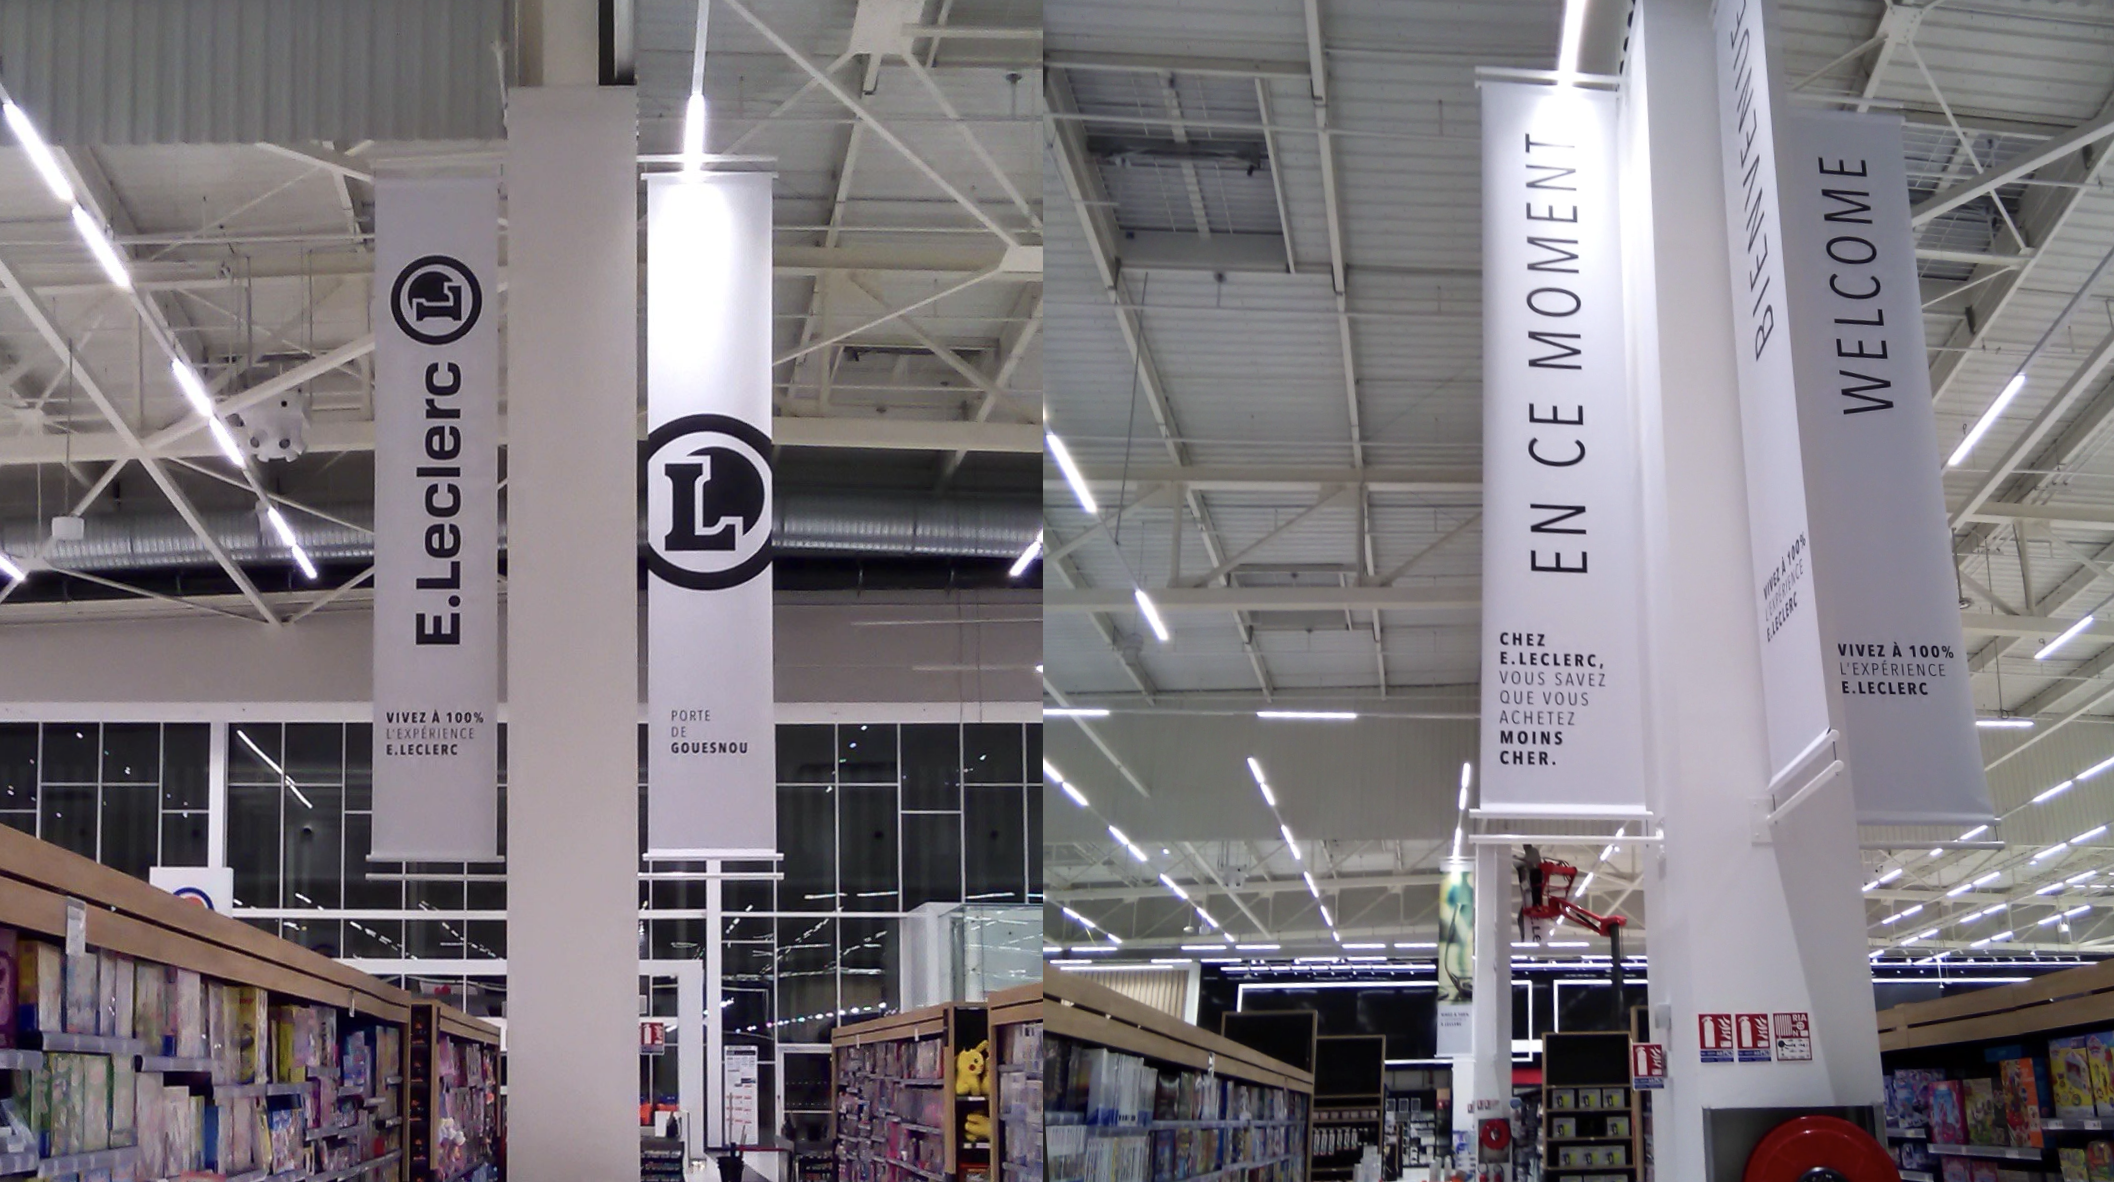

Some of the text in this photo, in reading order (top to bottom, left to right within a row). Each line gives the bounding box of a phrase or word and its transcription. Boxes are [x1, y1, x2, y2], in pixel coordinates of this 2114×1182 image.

[1730, 0, 1775, 362] BIENVENUE
[1817, 156, 1895, 415] WELCOME
[1524, 132, 1588, 574] EN CE MOMENT
[416, 361, 462, 646] E.Leclerc
[1763, 566, 1781, 601] VIVEZ
[1787, 531, 1807, 566] 100%
[1766, 591, 1798, 643] E.LECLERC
[1499, 631, 1546, 647] CHEZ
[1837, 641, 1955, 659] VIVEZ À 100%
[1499, 651, 1604, 669] E.LECLERC,
[1839, 660, 1947, 677] L'EXPÉRIENCE
[1499, 670, 1606, 687] VOUS SAVEZ
[1841, 680, 1929, 696] E.LECLERC
[1499, 690, 1590, 707] QUE VOUS
[386, 709, 485, 724] VIVEZ À 100%
[670, 709, 711, 722] PORTE
[1499, 710, 1576, 726] ACHETEZ
[386, 725, 475, 740] L'EXPÉRIENCE
[670, 725, 687, 738] DE
[1499, 730, 1564, 745] MOINS
[386, 743, 458, 756] E.LECLERC
[670, 741, 748, 754] GOUESNOU
[1499, 750, 1557, 766] CHER.
[1792, 1013, 1807, 1022] RIA
